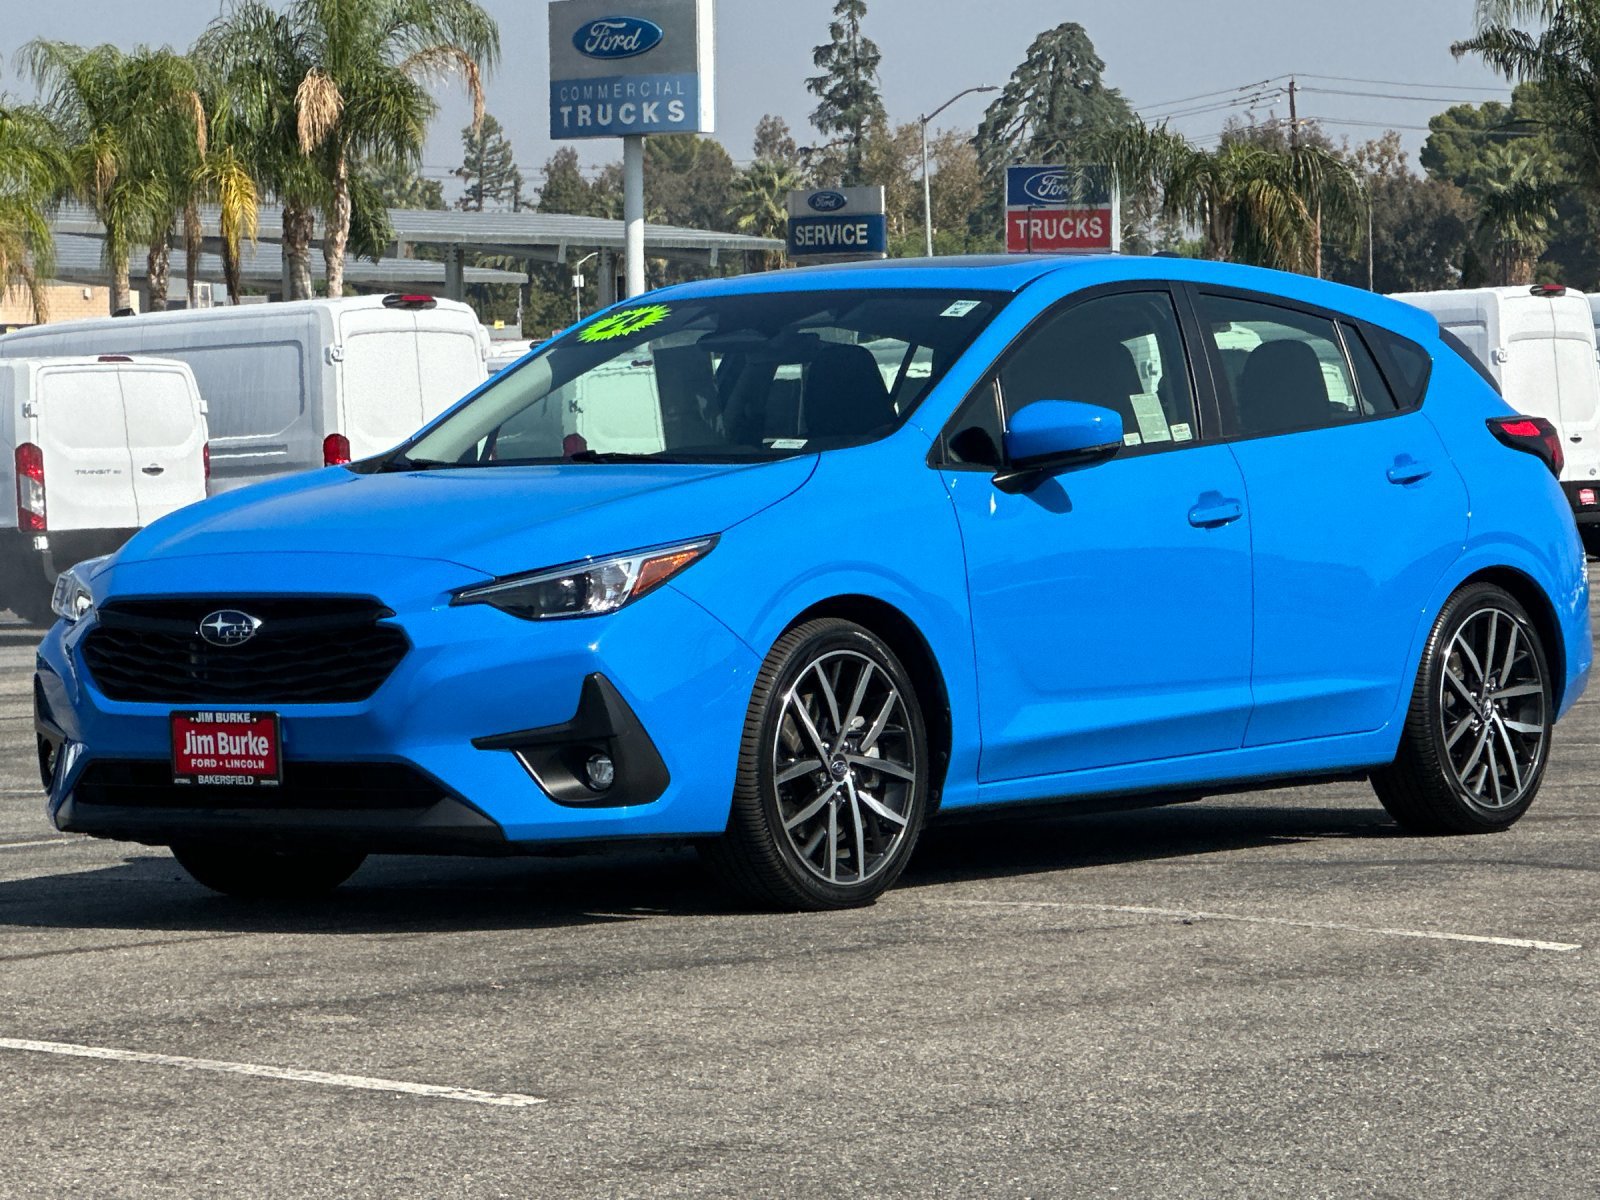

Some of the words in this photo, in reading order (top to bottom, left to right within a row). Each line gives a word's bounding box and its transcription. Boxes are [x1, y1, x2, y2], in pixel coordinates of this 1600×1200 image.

[585, 21, 642, 52] Ford
[560, 81, 685, 101] COMMERCIAL
[560, 100, 685, 128] TRUCKS
[1037, 174, 1080, 196] For
[815, 195, 837, 207] Ford
[795, 223, 868, 246] SERVICE
[1015, 217, 1103, 239] TRUCKS
[196, 712, 213, 723] JIM
[215, 712, 251, 723] BURKE
[183, 730, 215, 755] Jim
[217, 730, 269, 756] Burke
[191, 759, 217, 768] FORD
[225, 759, 265, 769] LINCOLN
[198, 775, 254, 785] BAKERSFIELD
